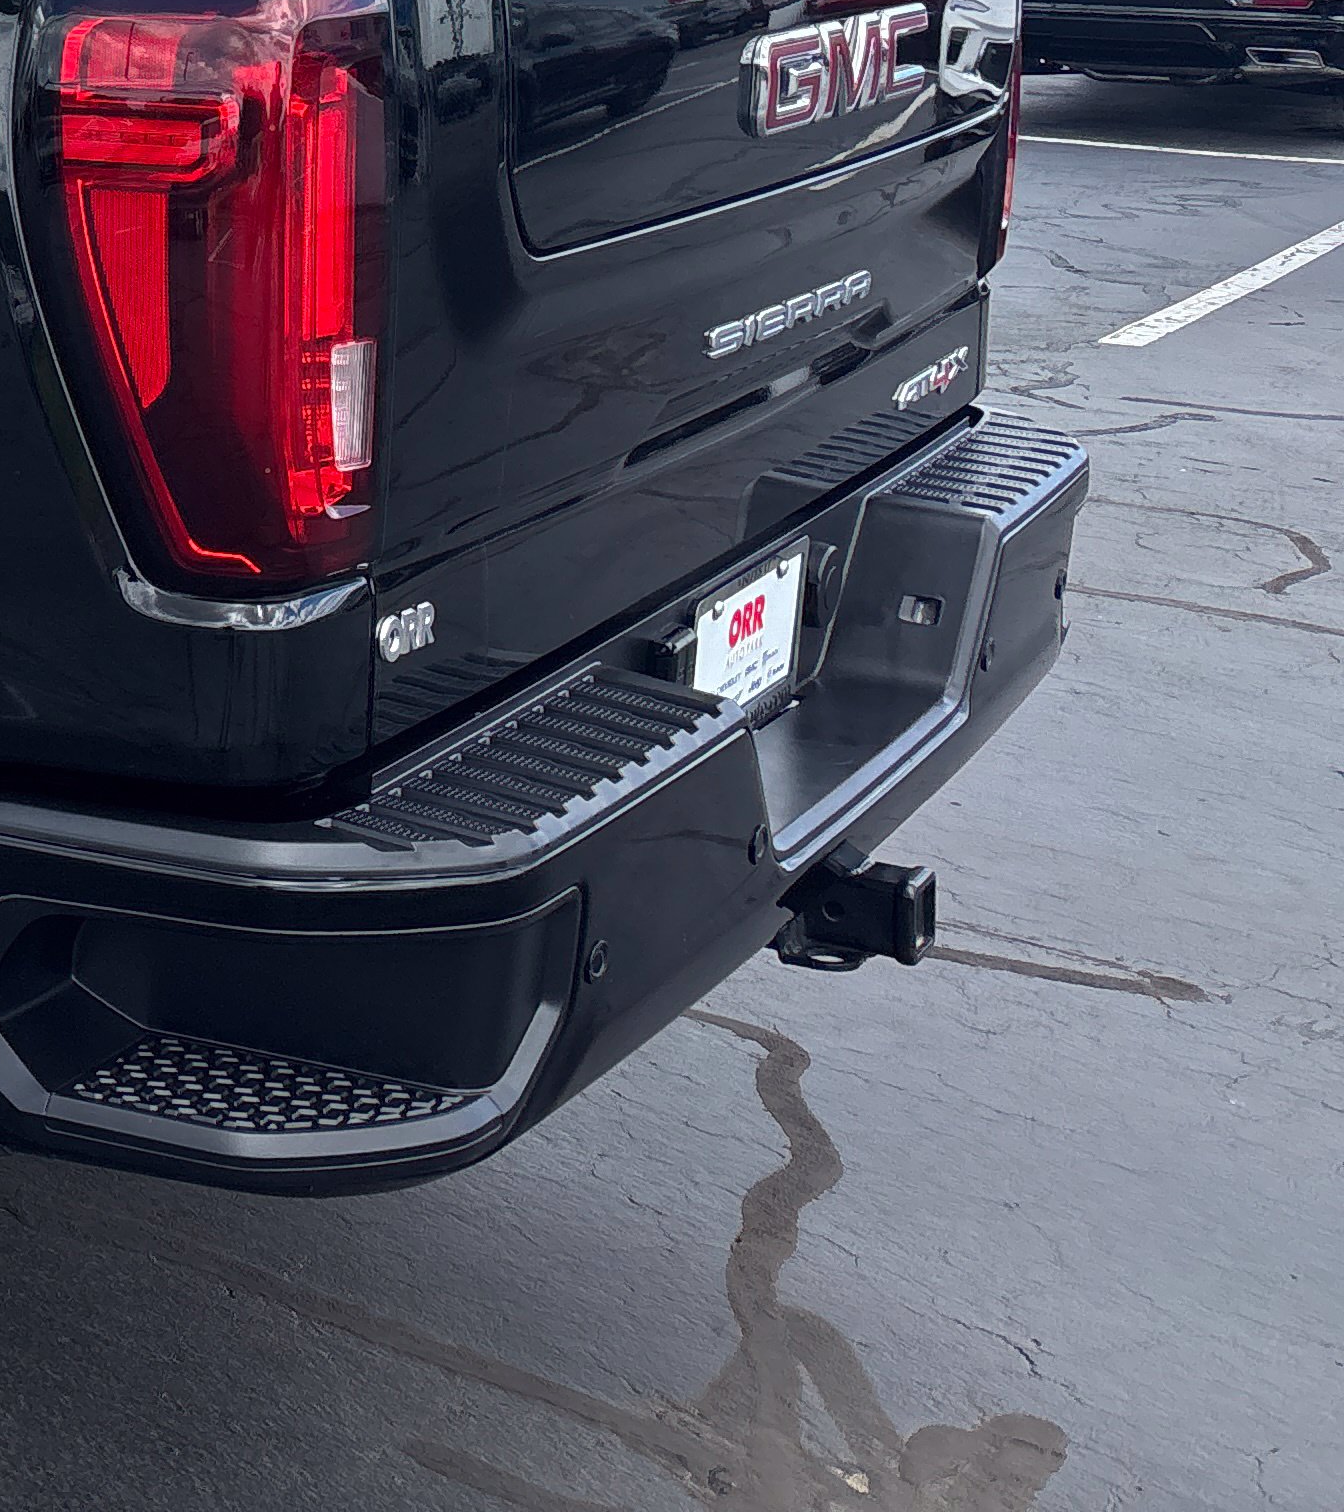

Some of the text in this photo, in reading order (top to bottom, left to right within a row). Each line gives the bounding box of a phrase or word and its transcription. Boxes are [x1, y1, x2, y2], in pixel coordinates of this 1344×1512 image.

[739, 2, 928, 138] GMC
[702, 270, 872, 359] SIERRA
[891, 346, 969, 411] AT4X
[376, 601, 435, 662] ORR
[728, 594, 766, 649] ORR
